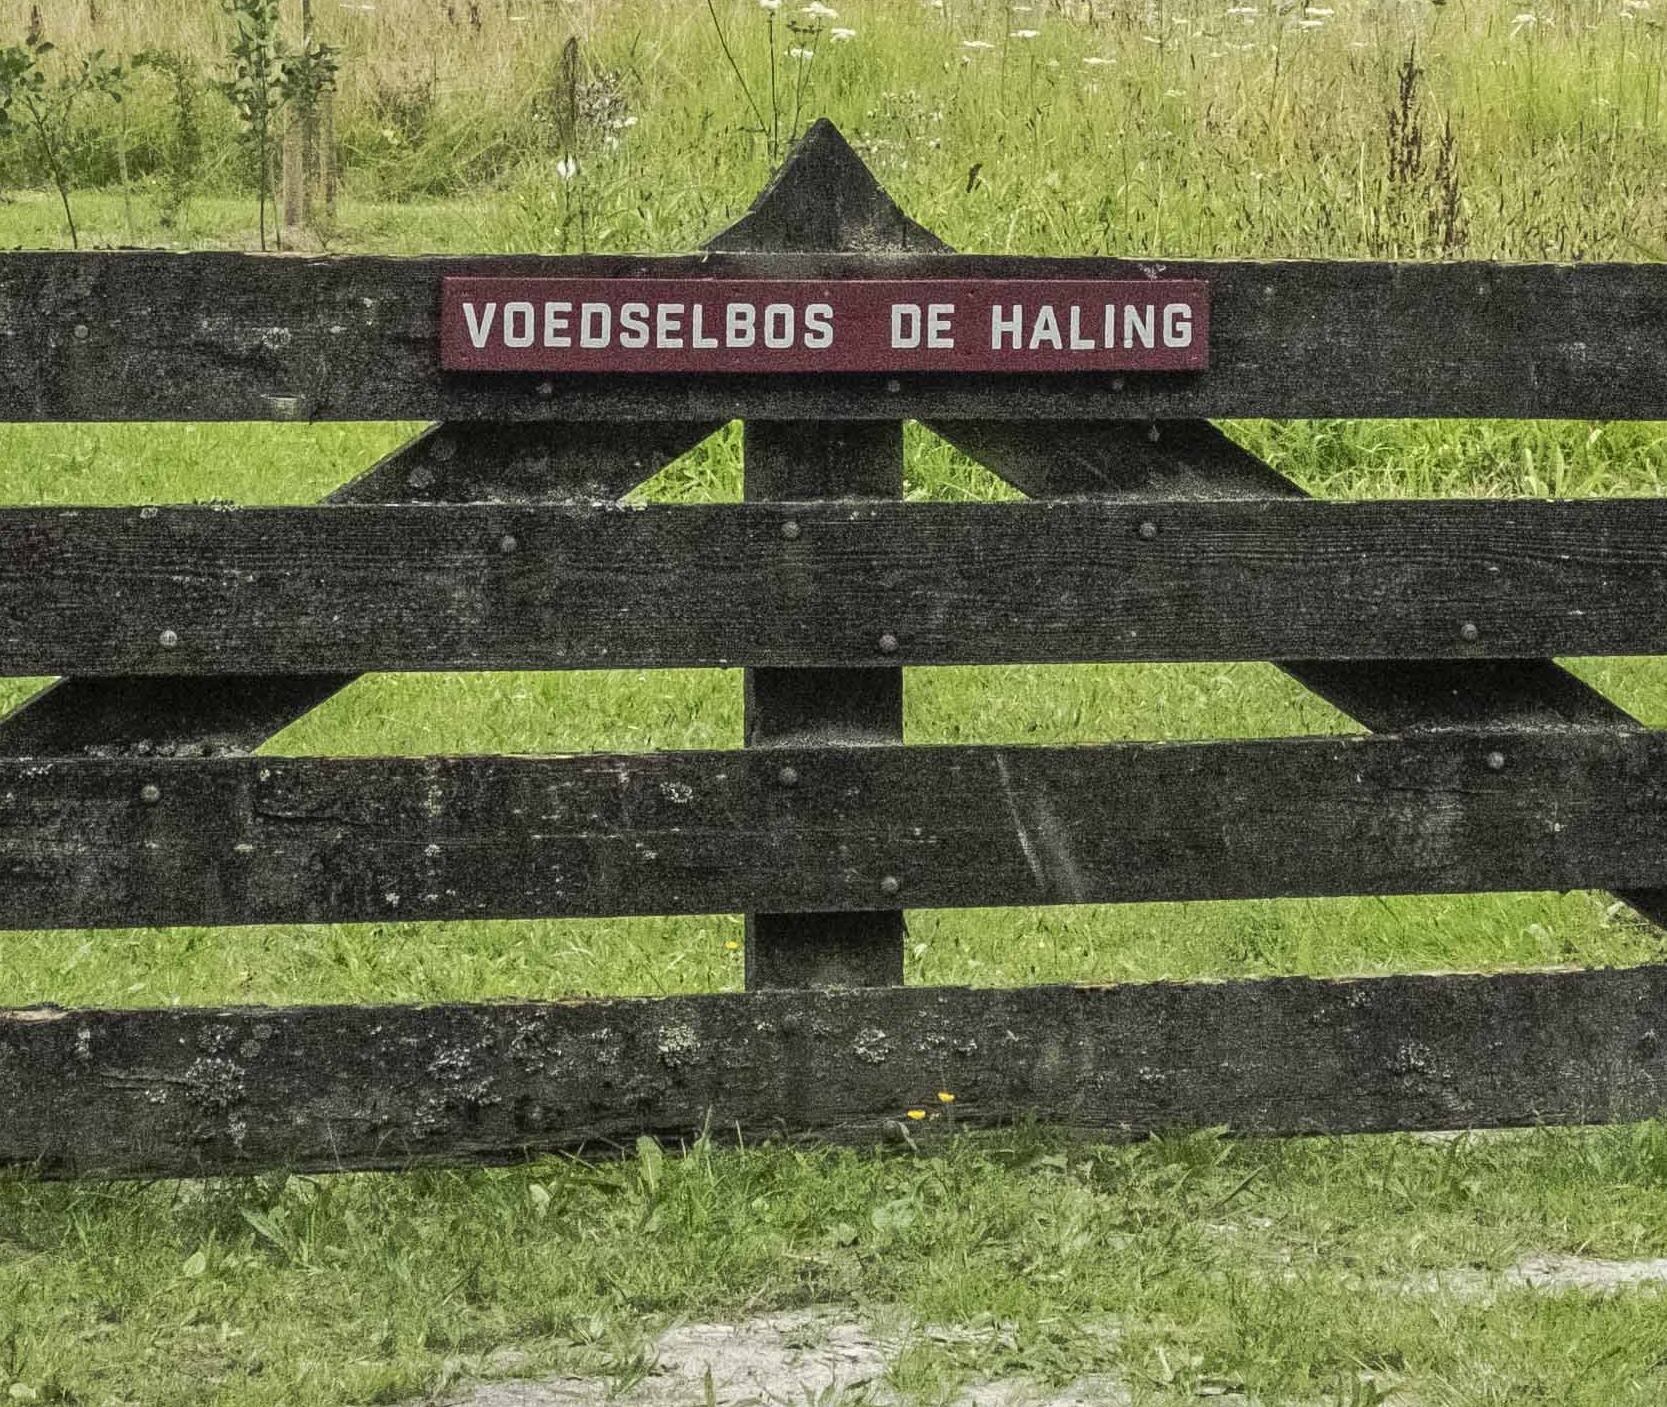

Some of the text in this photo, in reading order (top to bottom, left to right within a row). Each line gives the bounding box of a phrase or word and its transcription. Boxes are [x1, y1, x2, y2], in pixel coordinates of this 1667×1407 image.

[463, 301, 1192, 350] VOEDSELBOS DE HALING
